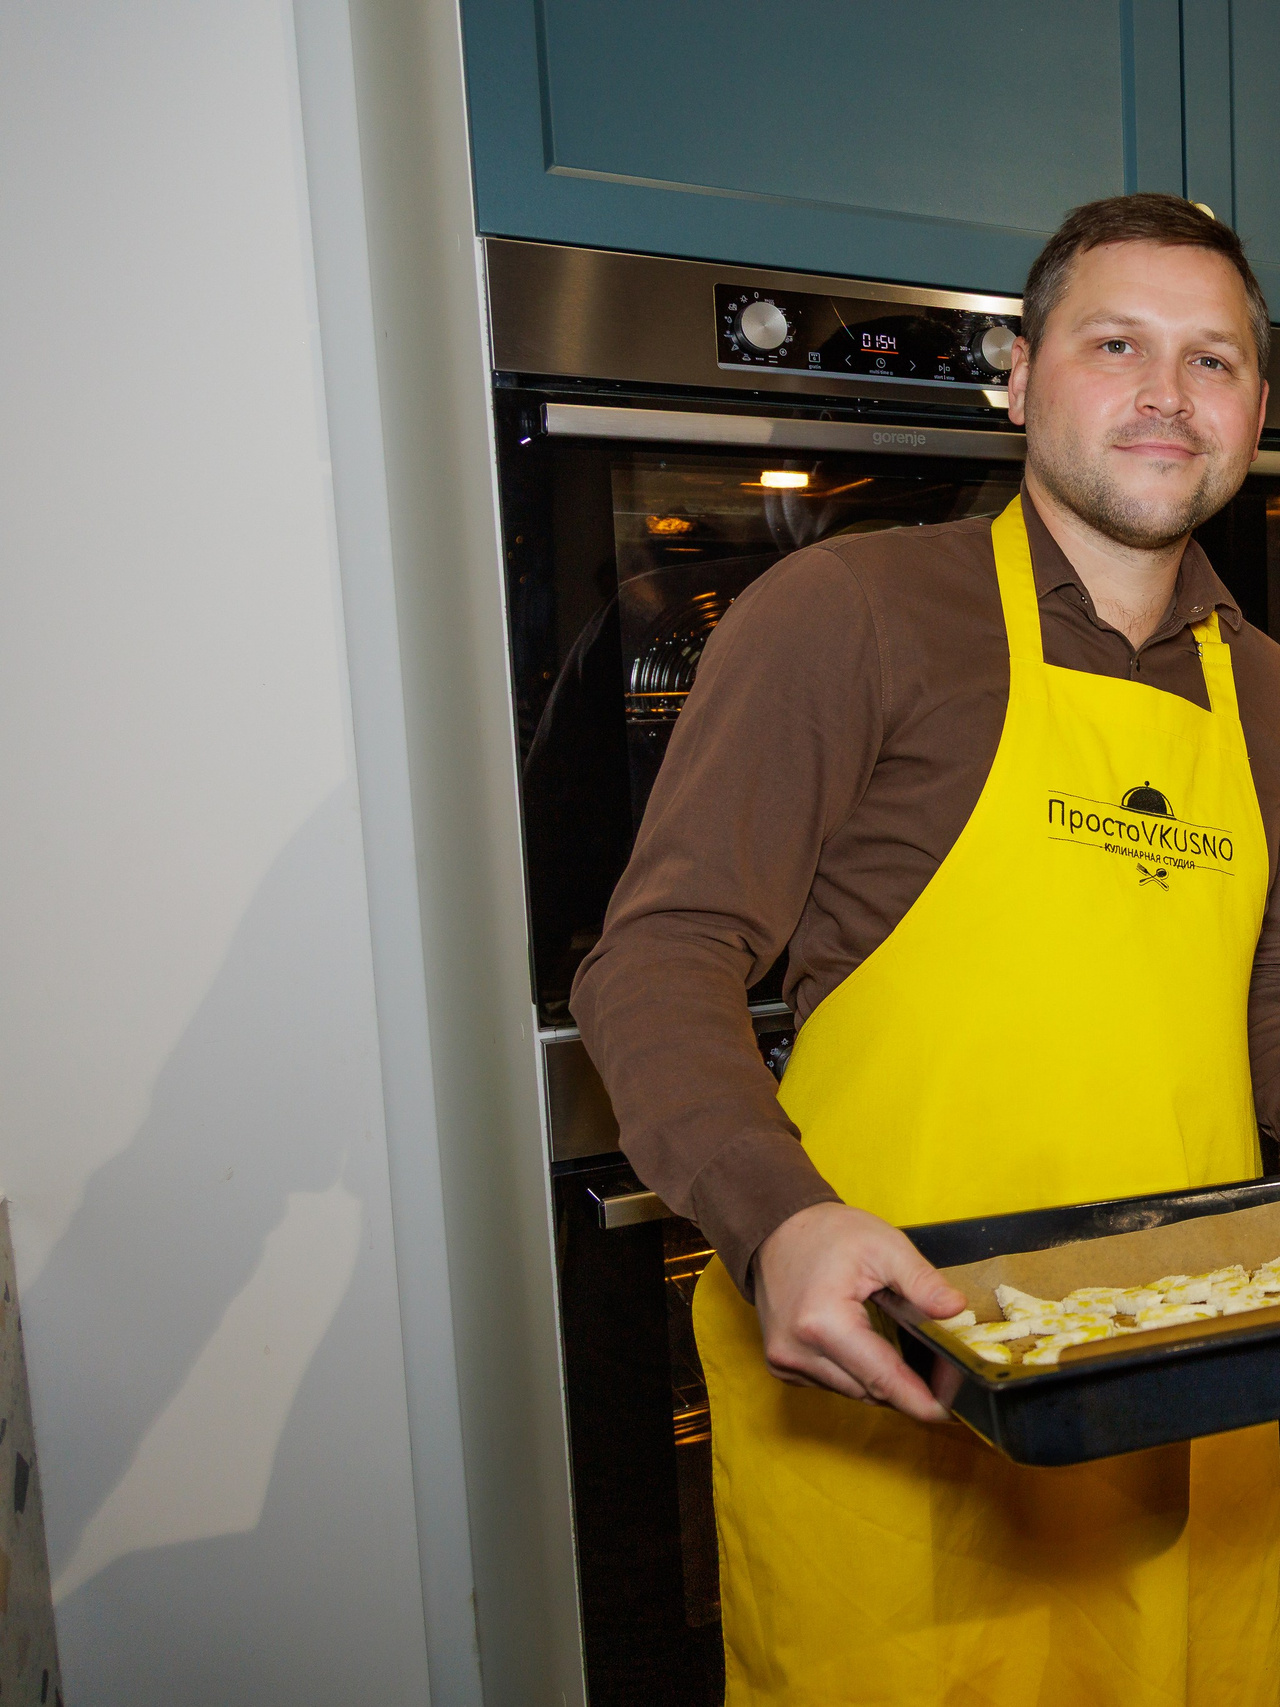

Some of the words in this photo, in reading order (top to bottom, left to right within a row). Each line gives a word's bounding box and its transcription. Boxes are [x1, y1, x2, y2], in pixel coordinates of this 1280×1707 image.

[872, 431, 927, 445] gorenje
[1048, 799, 1234, 862] ПростоVKUSNO
[1104, 842, 1161, 864] КУЛИНАРНАЯ
[1163, 856, 1196, 870] СТУДИЯ
